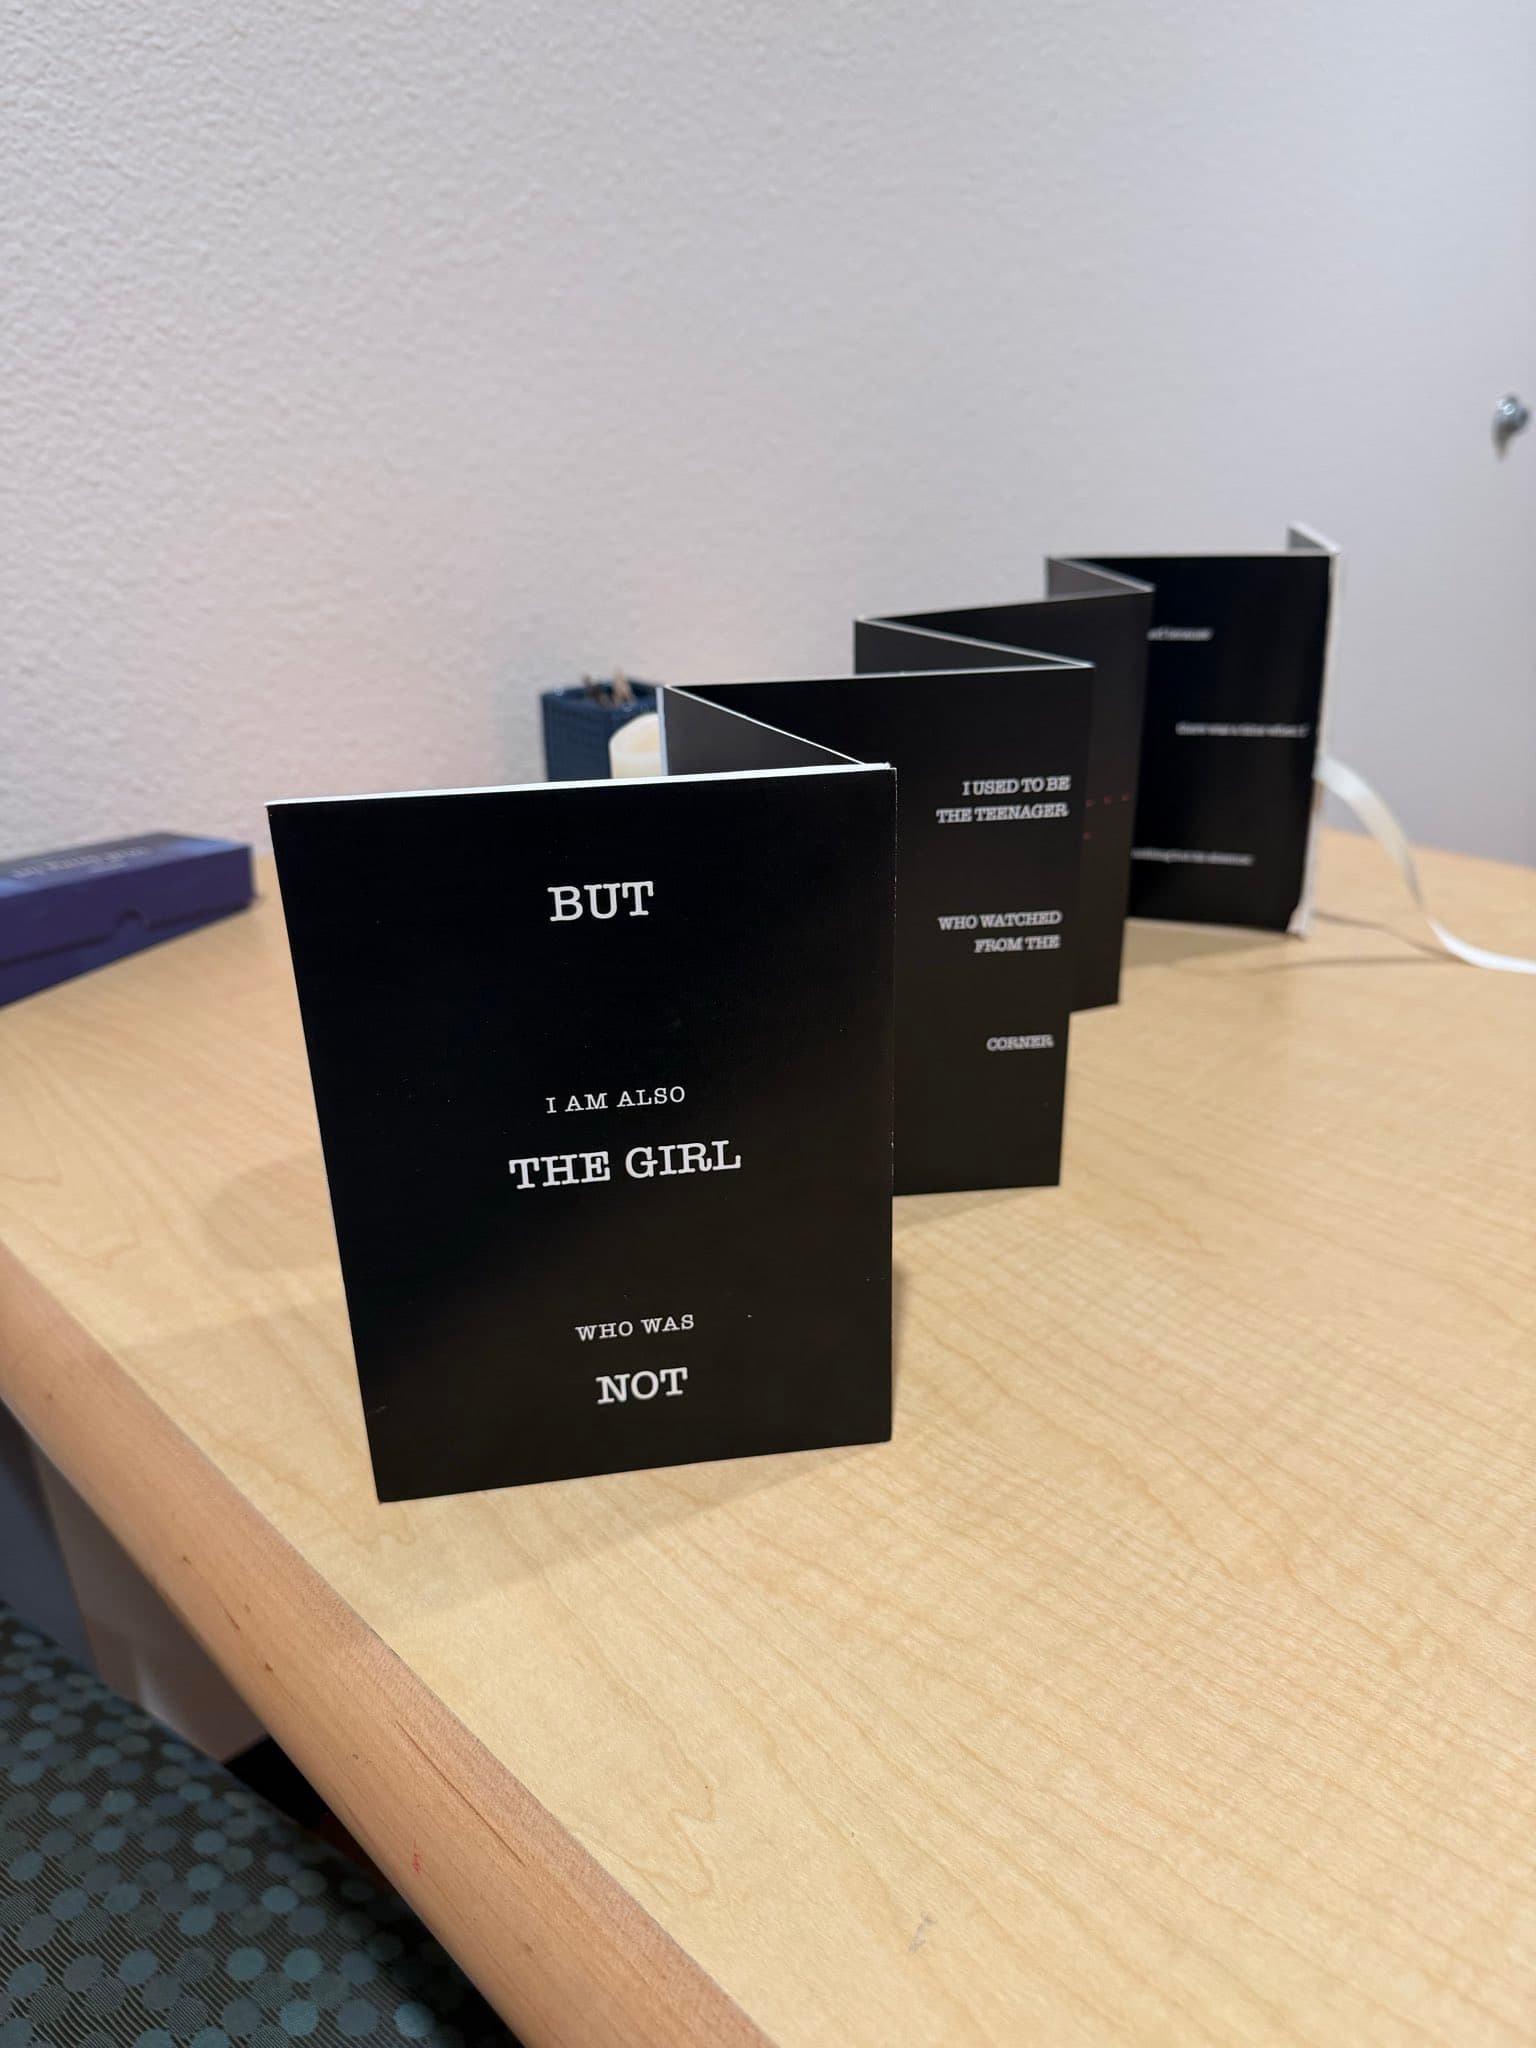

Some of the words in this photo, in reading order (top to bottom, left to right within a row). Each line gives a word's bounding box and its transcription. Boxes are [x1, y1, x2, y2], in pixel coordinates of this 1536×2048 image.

[962, 780, 970, 796] I
[972, 779, 1019, 796] USED
[1021, 777, 1045, 793] TO
[1046, 775, 1071, 792] BE
[936, 807, 973, 824] THE
[975, 802, 1069, 822] TEENAGER
[547, 880, 654, 922] BUT
[937, 914, 978, 931] WHO
[979, 910, 1062, 928] WATCHED
[974, 936, 1024, 953] FROM
[1025, 934, 1061, 951] THE
[986, 1034, 1054, 1052] CORNER
[546, 1096, 557, 1114] I
[564, 1092, 609, 1113] AM
[616, 1085, 686, 1108] ALSO
[508, 1150, 611, 1190] THE
[625, 1139, 742, 1179] GIRL
[575, 1320, 634, 1342] WHO
[641, 1314, 695, 1334] WAS
[595, 1366, 689, 1405] NOT
